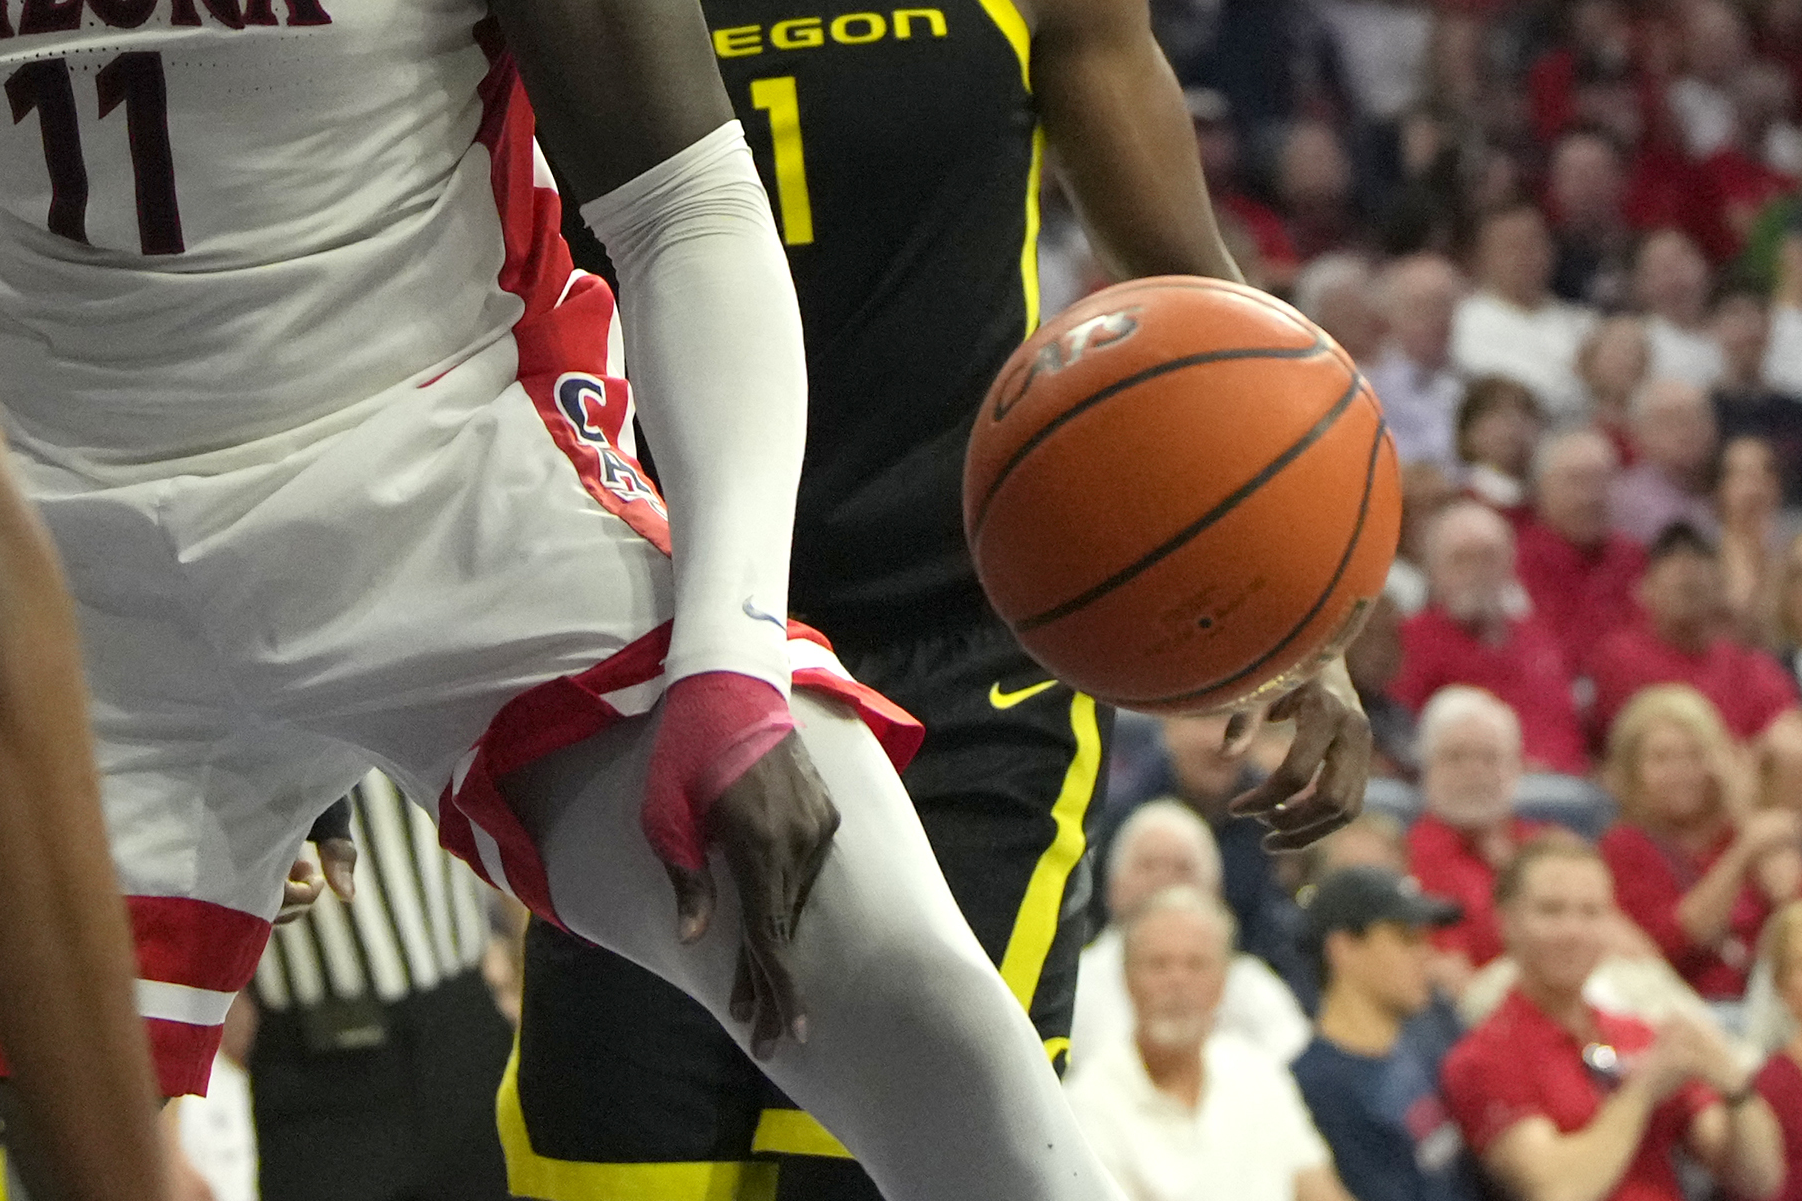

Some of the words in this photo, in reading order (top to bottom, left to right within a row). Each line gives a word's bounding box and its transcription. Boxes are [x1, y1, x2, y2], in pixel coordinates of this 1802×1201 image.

[713, 8, 947, 58] EGON
[4, 51, 186, 256] 11
[750, 76, 814, 245] 1
